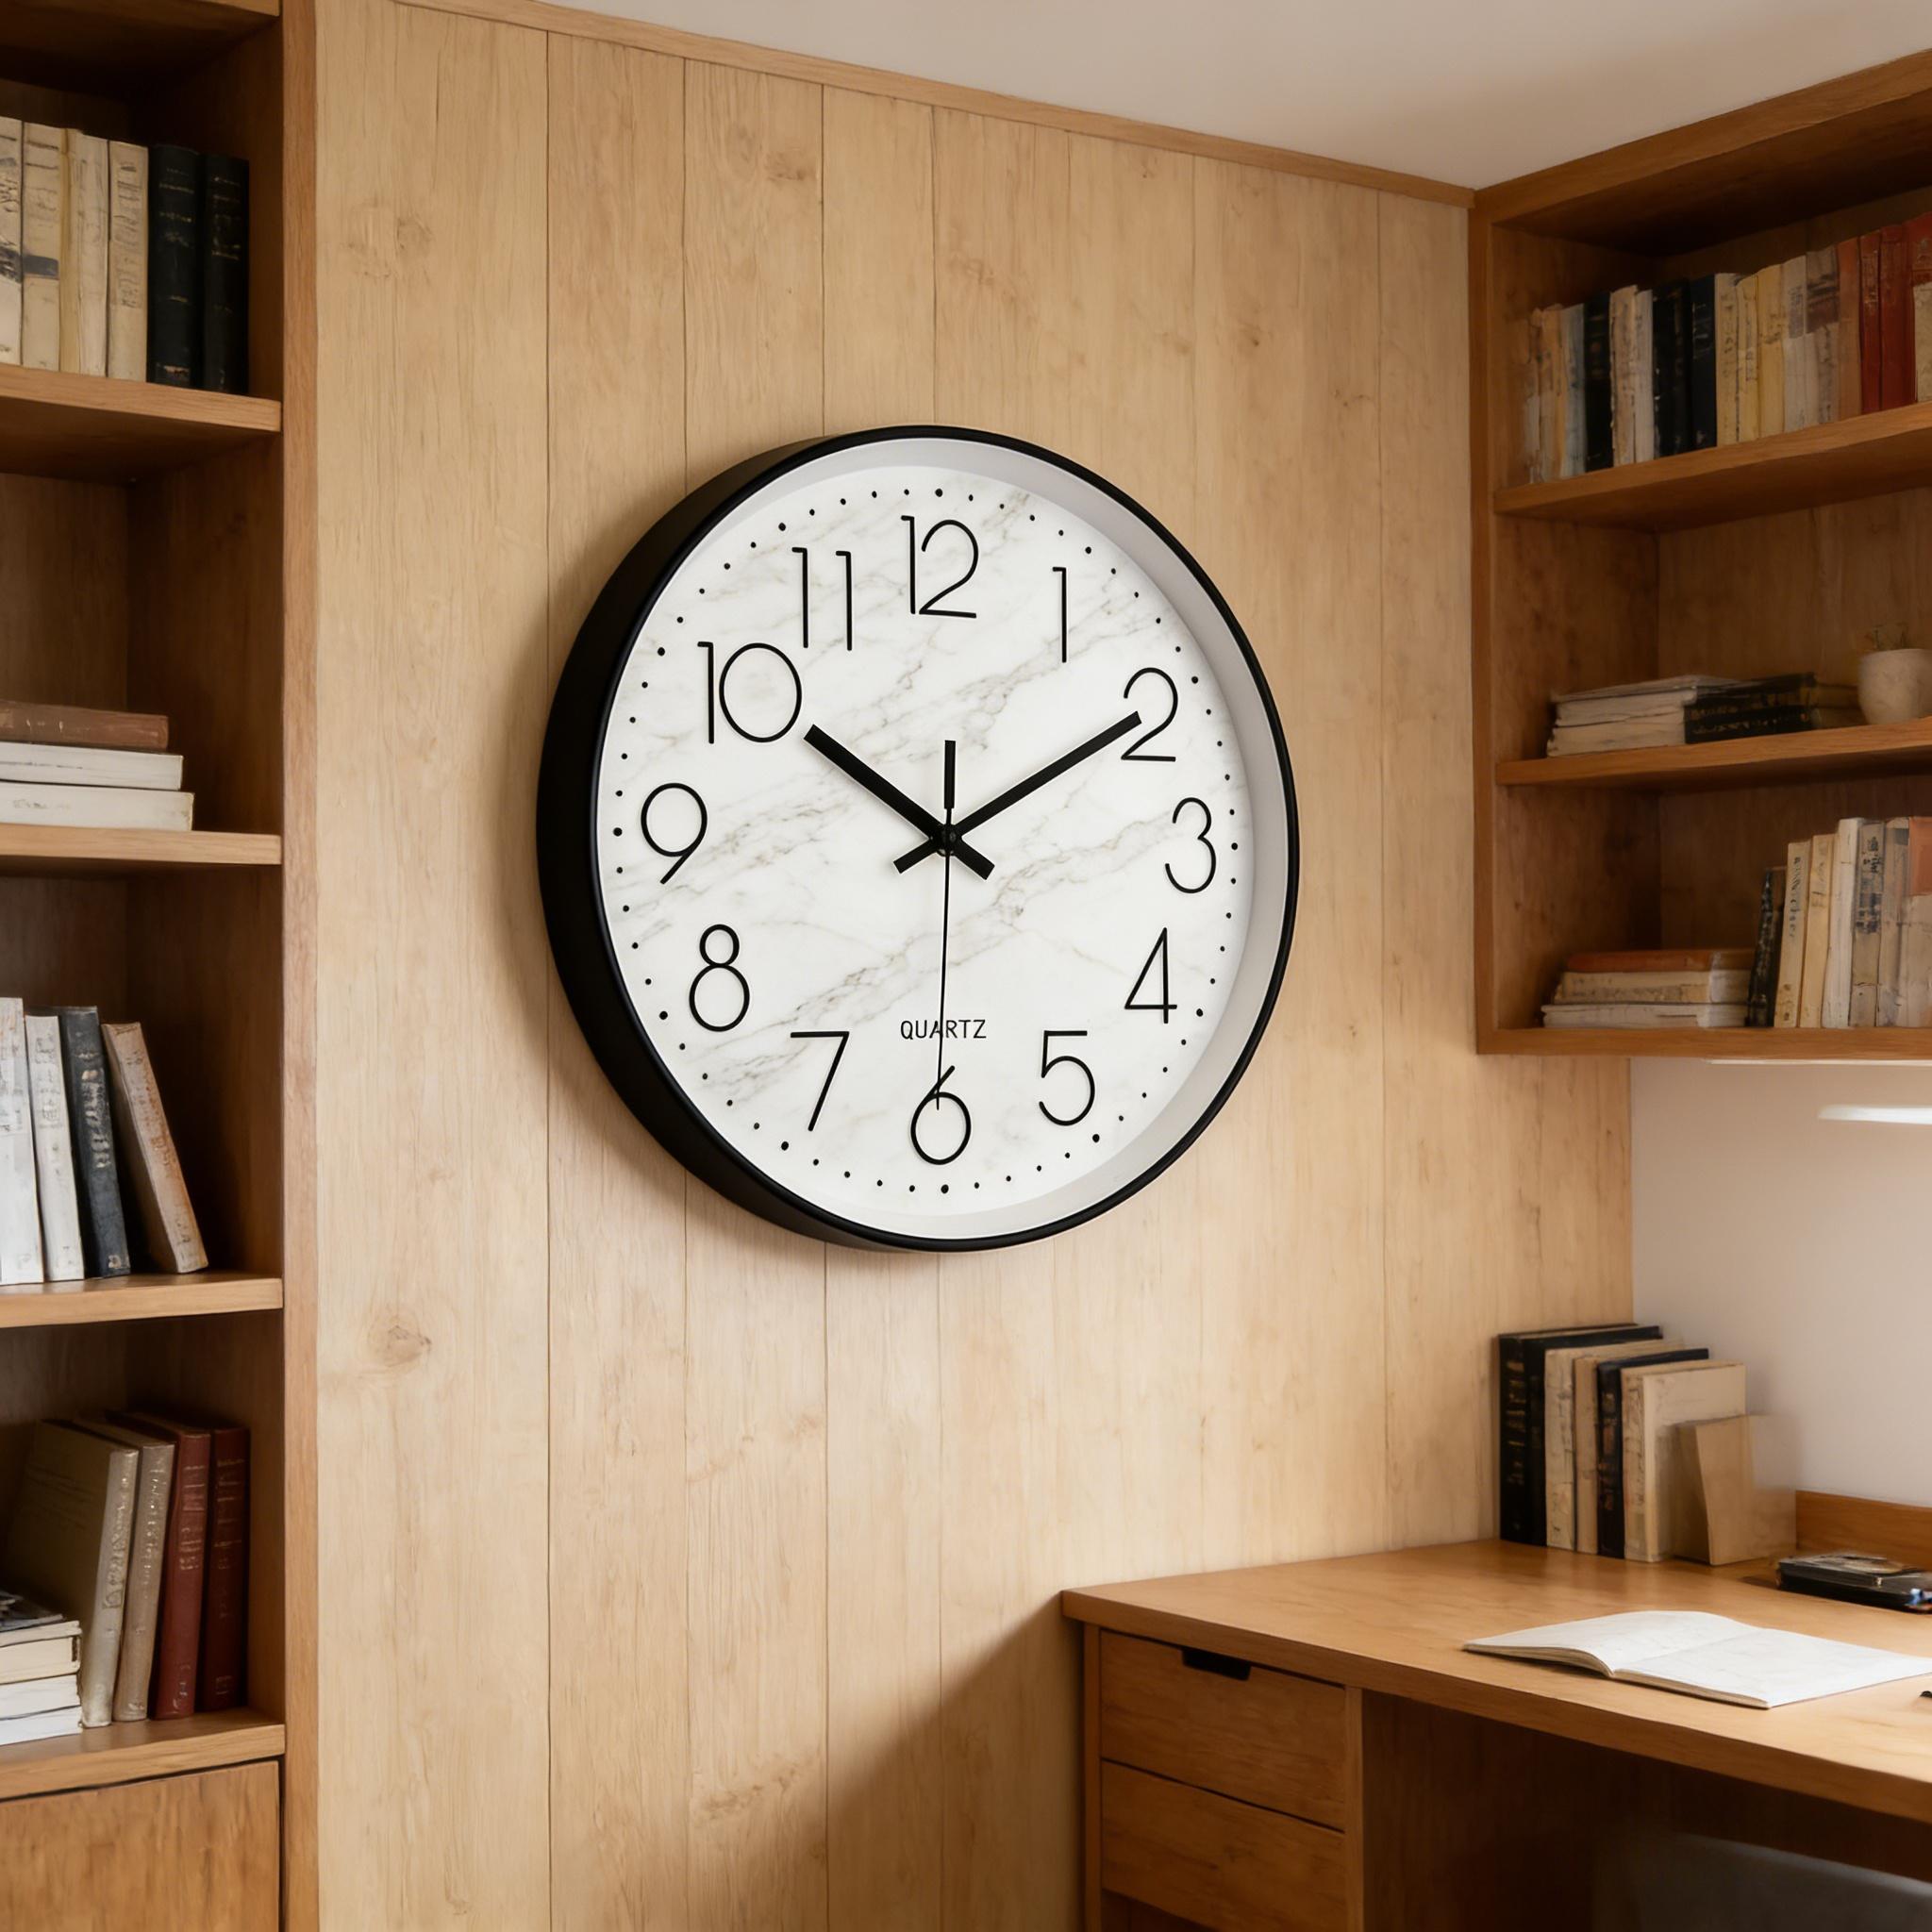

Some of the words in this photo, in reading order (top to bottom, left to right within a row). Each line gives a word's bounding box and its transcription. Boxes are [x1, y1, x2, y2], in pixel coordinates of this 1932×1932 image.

[792, 547, 852, 651] 11
[901, 515, 978, 618] 12
[1053, 567, 1066, 662] 1
[697, 640, 802, 743] 10
[1121, 667, 1178, 762] 2
[641, 783, 708, 884] 9
[1165, 798, 1216, 893] 3
[689, 924, 749, 1032] 8
[1124, 927, 1177, 1024] 4
[900, 1020, 987, 1040] QUARTZ
[1040, 1030, 1095, 1125] 5
[791, 1031, 849, 1131] 7
[910, 1064, 971, 1165] 6
